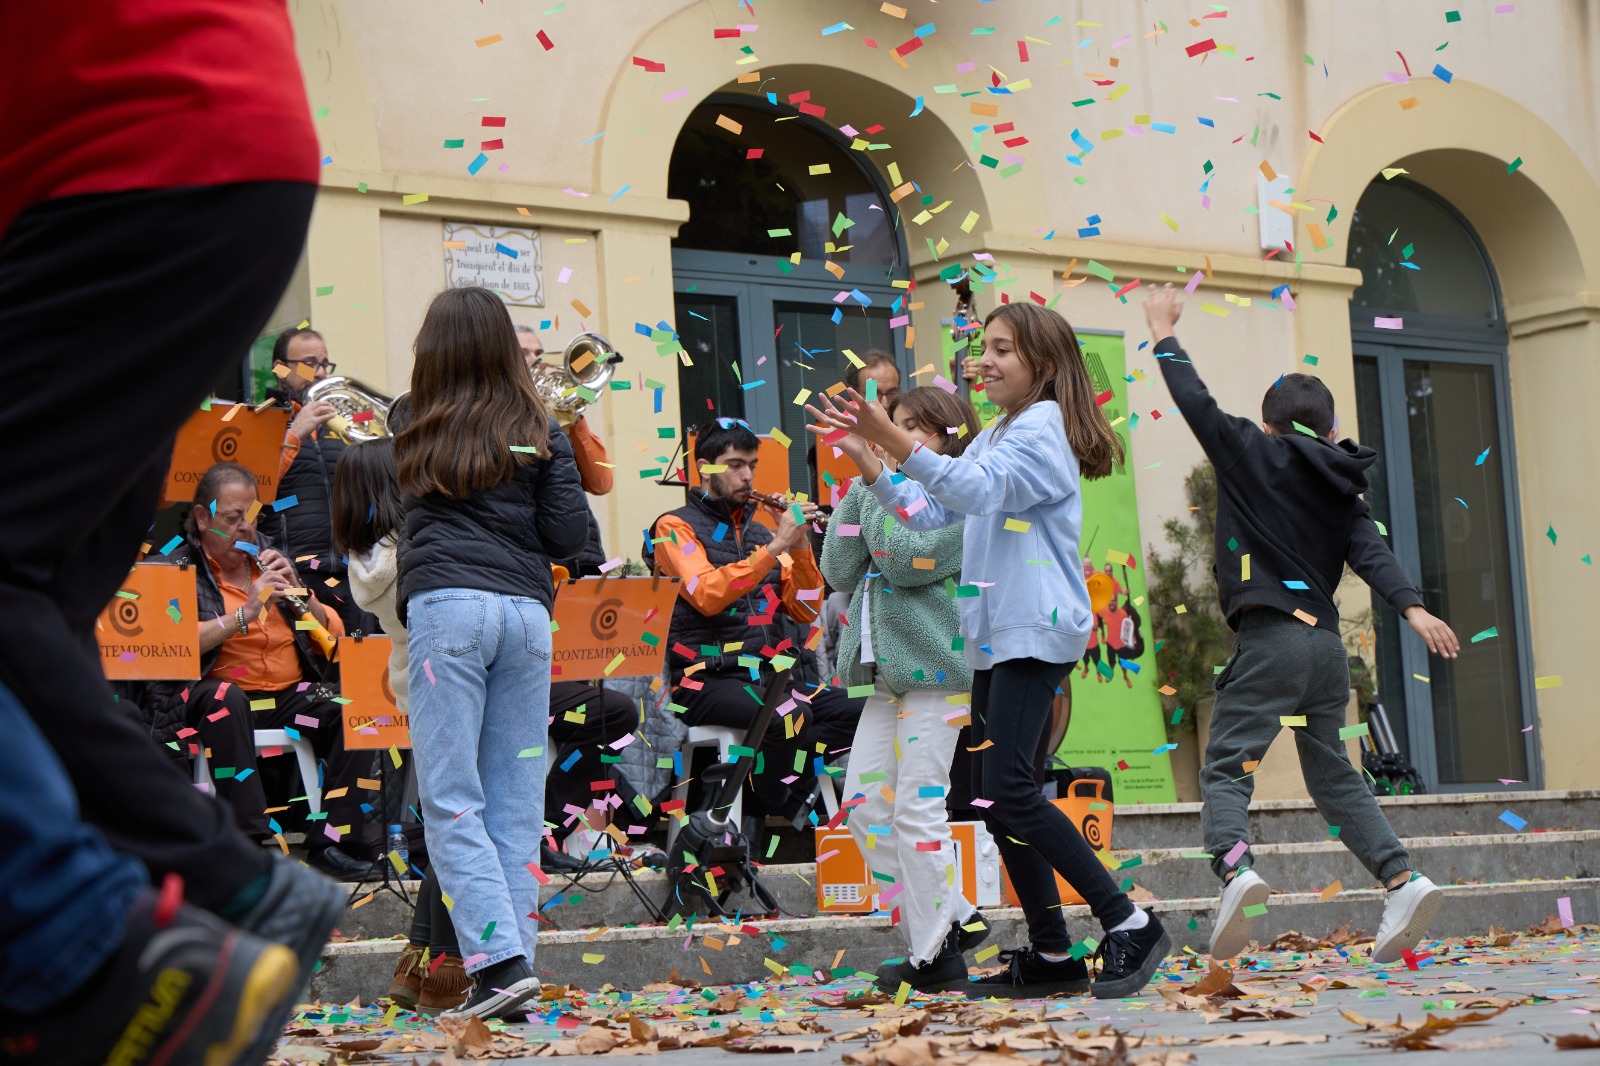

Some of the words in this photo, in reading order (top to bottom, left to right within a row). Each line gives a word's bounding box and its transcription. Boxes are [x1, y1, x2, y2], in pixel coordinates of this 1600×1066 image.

[498, 262, 506, 272] el
[523, 263, 532, 274] de
[502, 278, 511, 289] de
[99, 643, 192, 657] TEMPORÀNIA
[553, 645, 657, 661] CONTEMPORÀNIA
